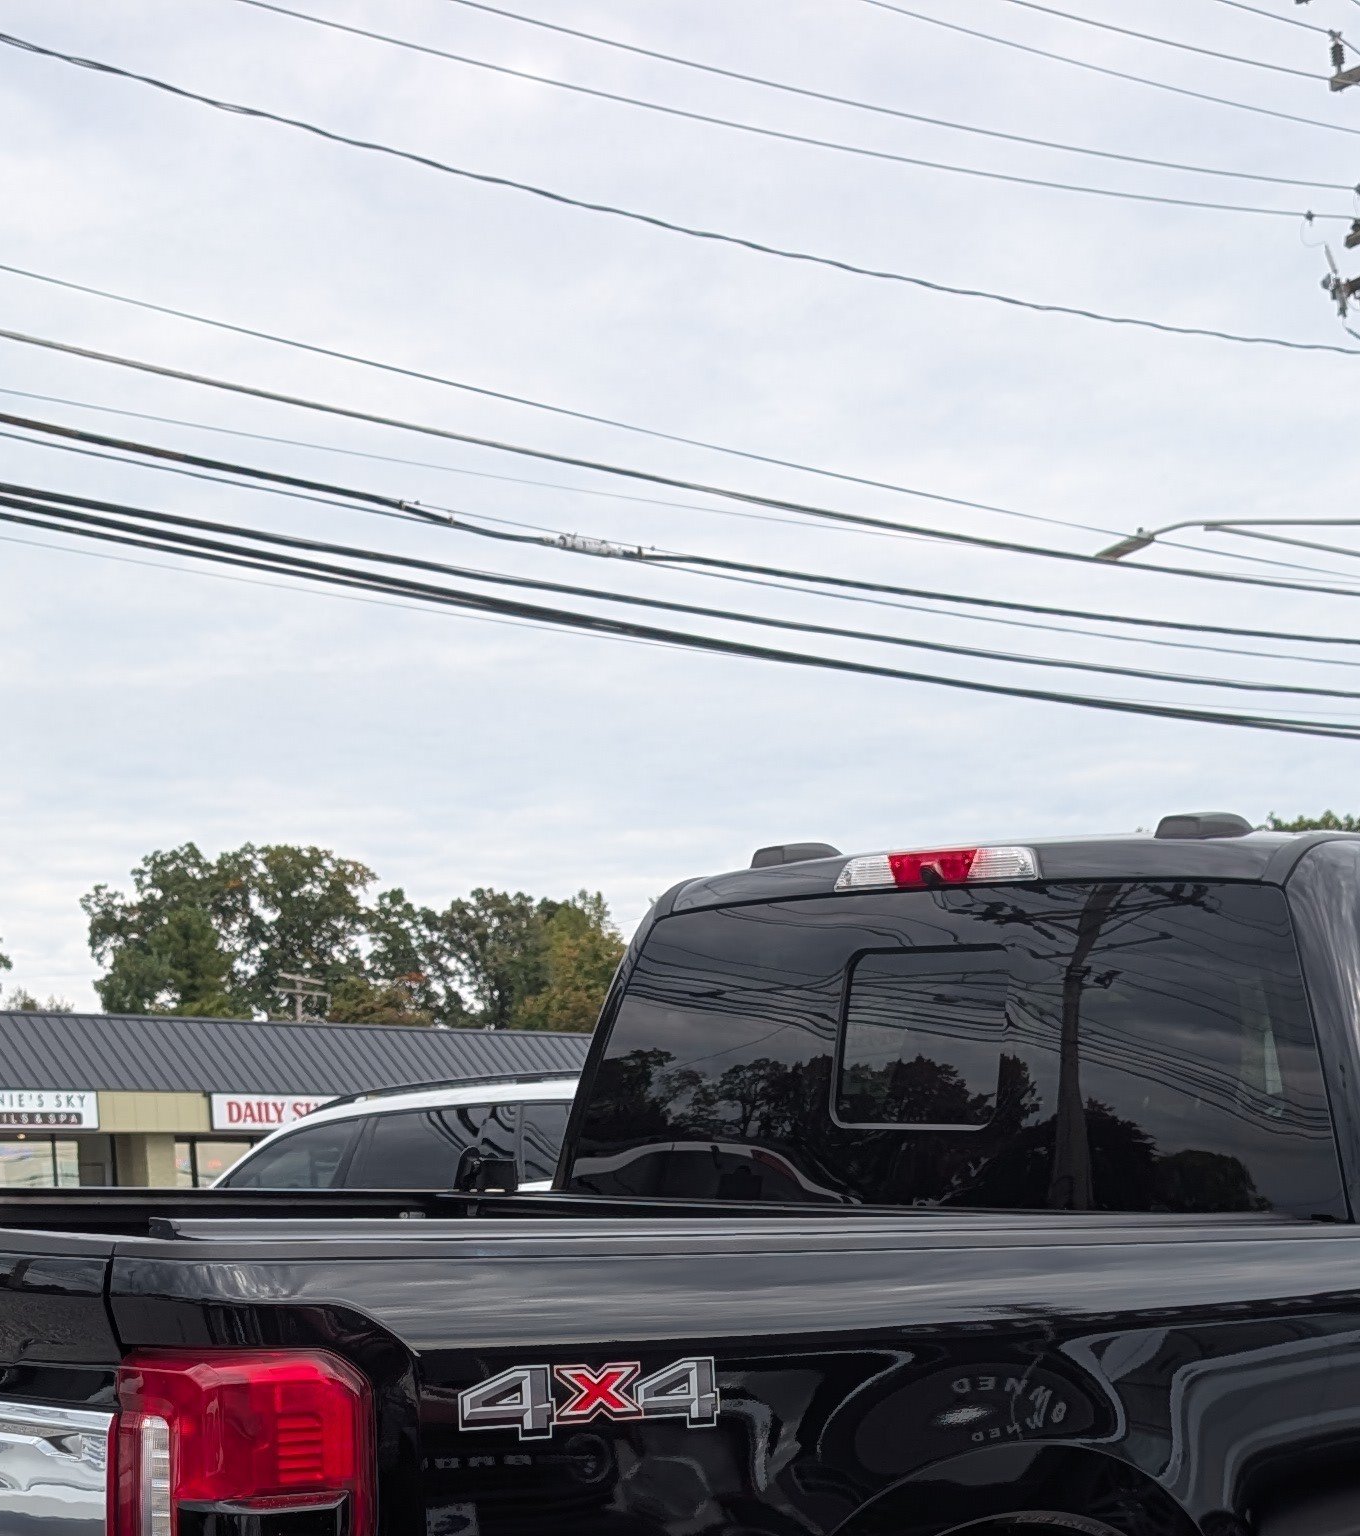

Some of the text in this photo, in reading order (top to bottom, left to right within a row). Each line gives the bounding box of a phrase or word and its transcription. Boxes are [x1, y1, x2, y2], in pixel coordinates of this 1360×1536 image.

[55, 1093, 86, 1108] SKY
[48, 1112, 79, 1125] SPA
[227, 1101, 287, 1124] DAILY
